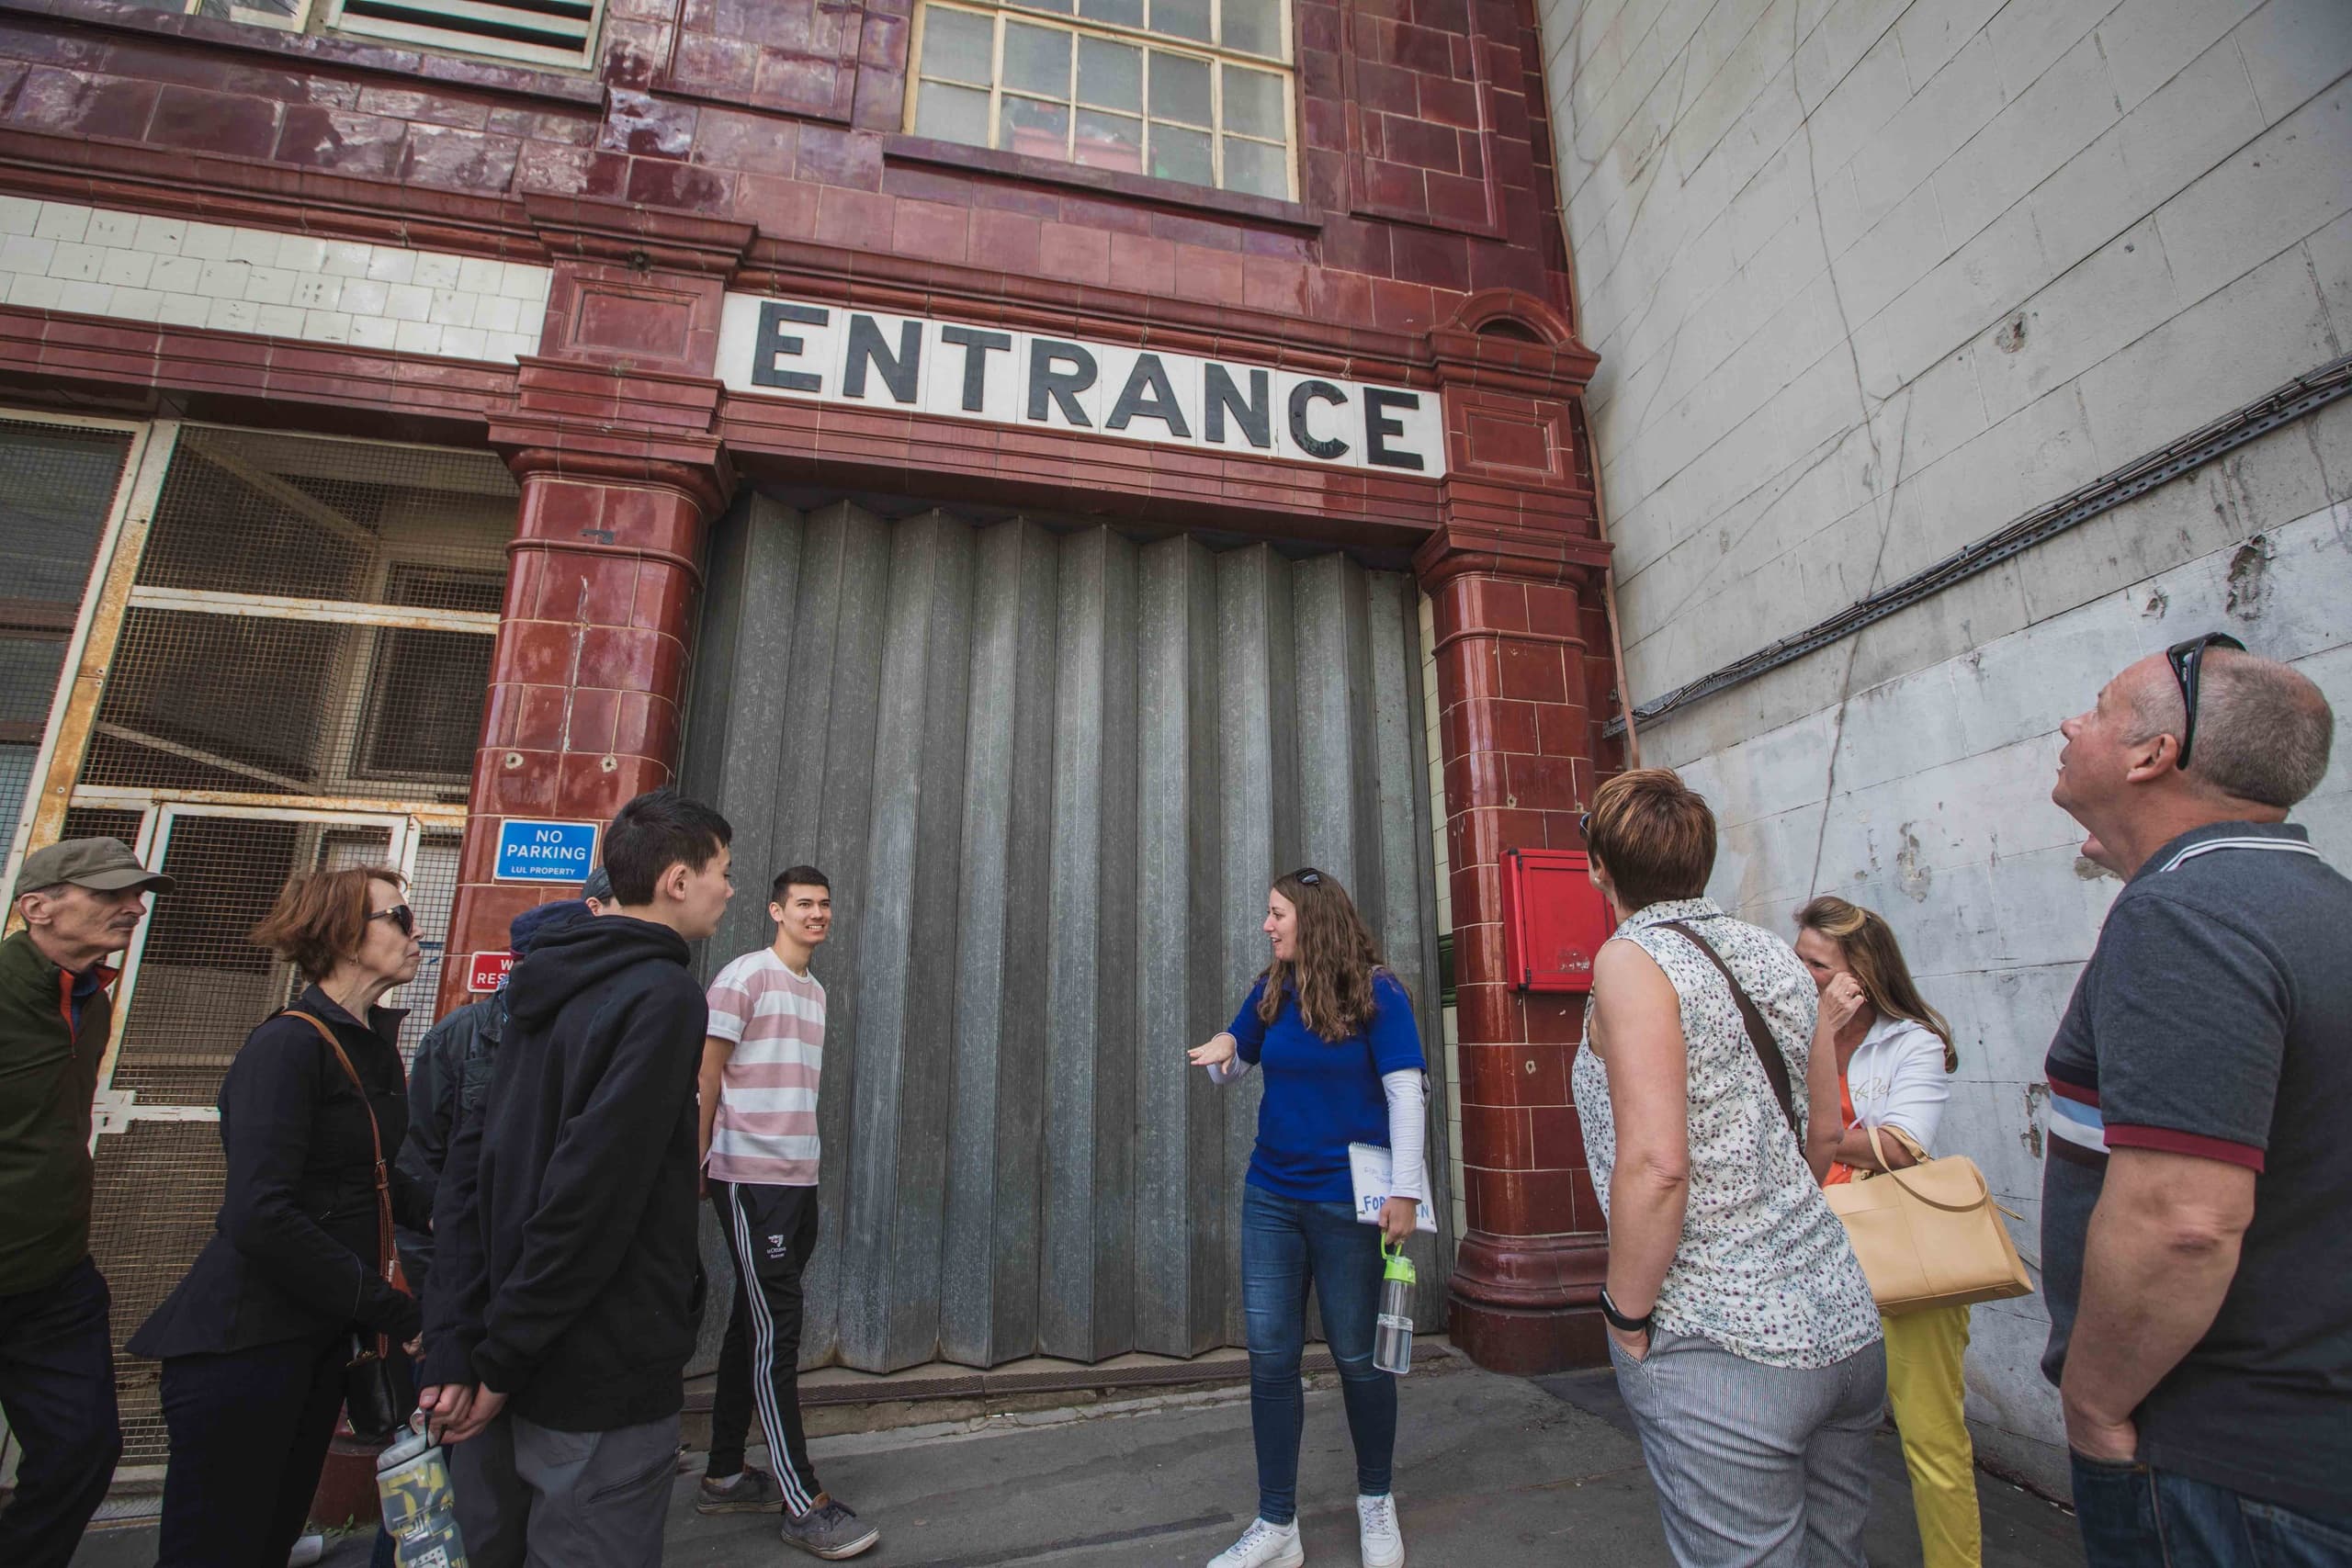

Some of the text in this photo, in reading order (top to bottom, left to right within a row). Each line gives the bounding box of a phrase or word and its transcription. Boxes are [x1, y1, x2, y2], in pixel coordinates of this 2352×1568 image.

[752, 300, 1424, 470] ENTRANCE
[536, 829, 563, 843] NO
[506, 844, 586, 861] PARKING
[511, 865, 575, 875] LUL PROPERTY
